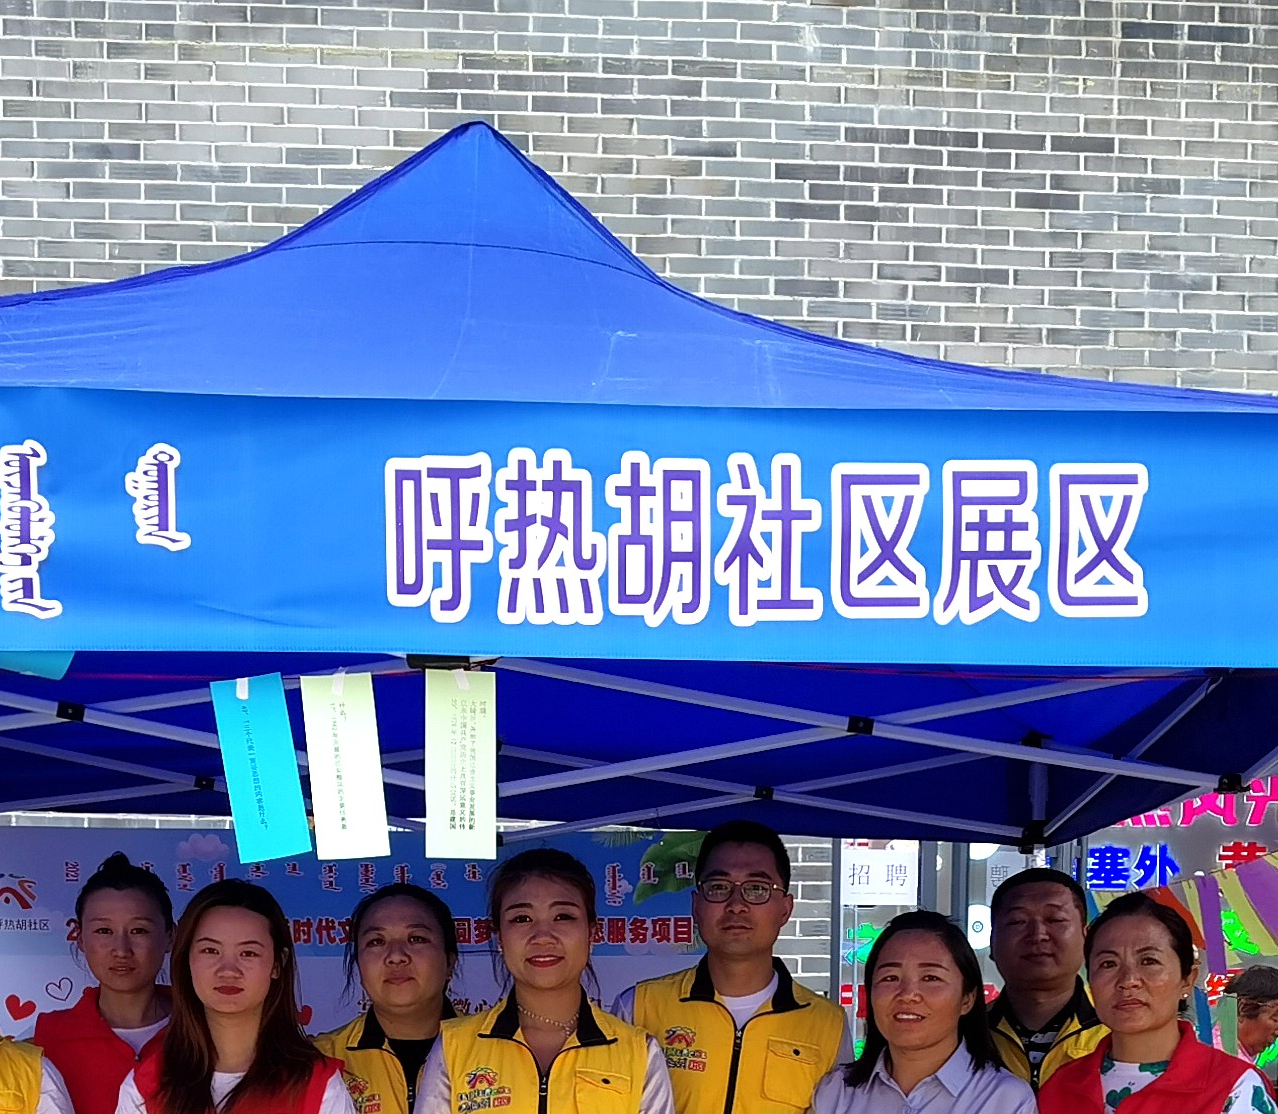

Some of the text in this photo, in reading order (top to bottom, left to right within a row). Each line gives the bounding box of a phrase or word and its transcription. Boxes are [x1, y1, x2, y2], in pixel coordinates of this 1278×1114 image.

[387, 449, 1147, 626] 呼热胡社区展区
[64, 860, 80, 883] 2021
[848, 863, 908, 887] 招聘
[1087, 843, 1180, 889] 塞外
